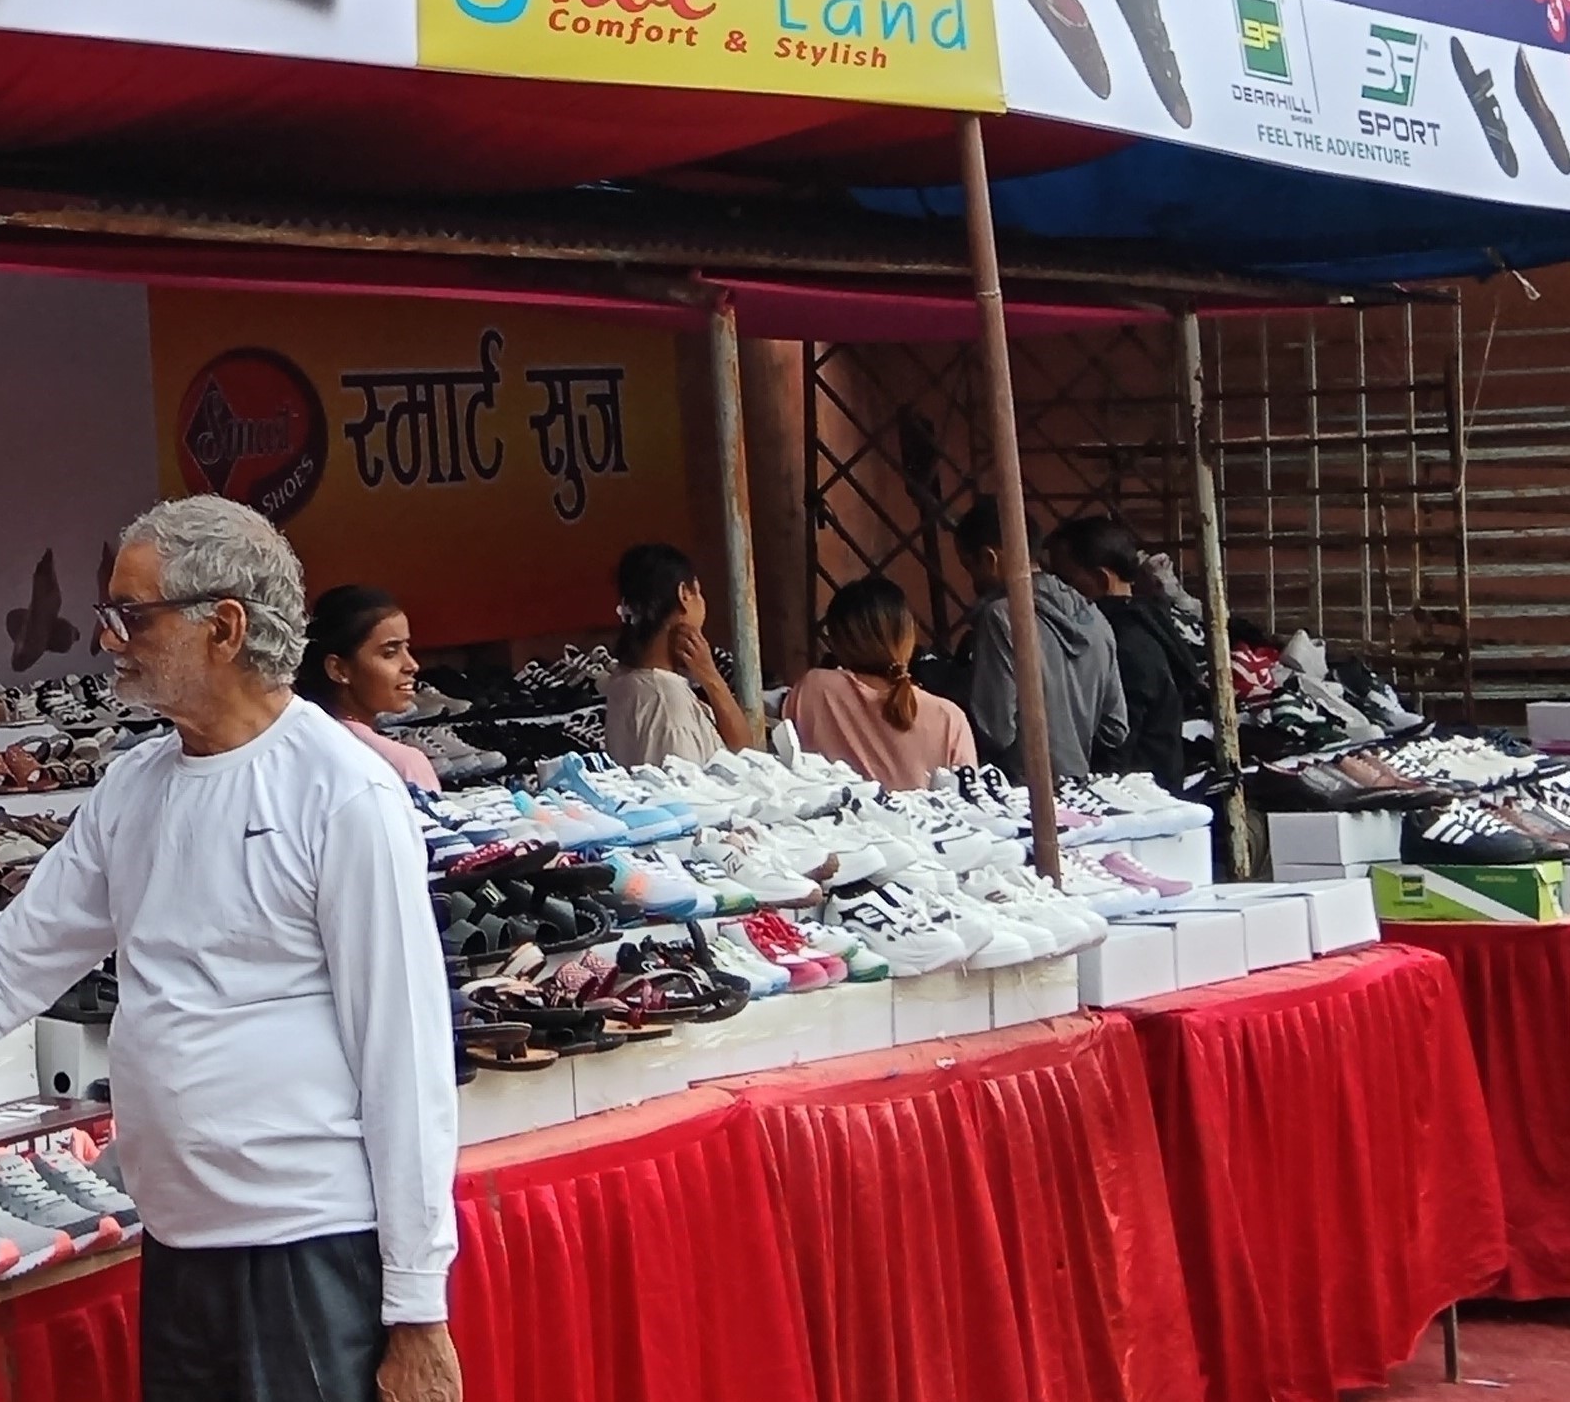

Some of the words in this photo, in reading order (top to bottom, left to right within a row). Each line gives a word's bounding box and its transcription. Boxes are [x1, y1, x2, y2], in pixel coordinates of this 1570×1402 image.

[548, 8, 699, 47] Comfort
[724, 30, 748, 54] &
[774, 37, 889, 69] Stylish
[1230, 84, 1312, 115] DEARHILL
[1257, 124, 1294, 147] FEEL
[1293, 131, 1322, 154] THE
[1326, 138, 1412, 168] ADVENTURE
[1358, 109, 1441, 147] SPORT
[340, 328, 507, 488] स्मार्ट
[524, 367, 630, 521] सुज
[261, 453, 315, 515] SHOES
